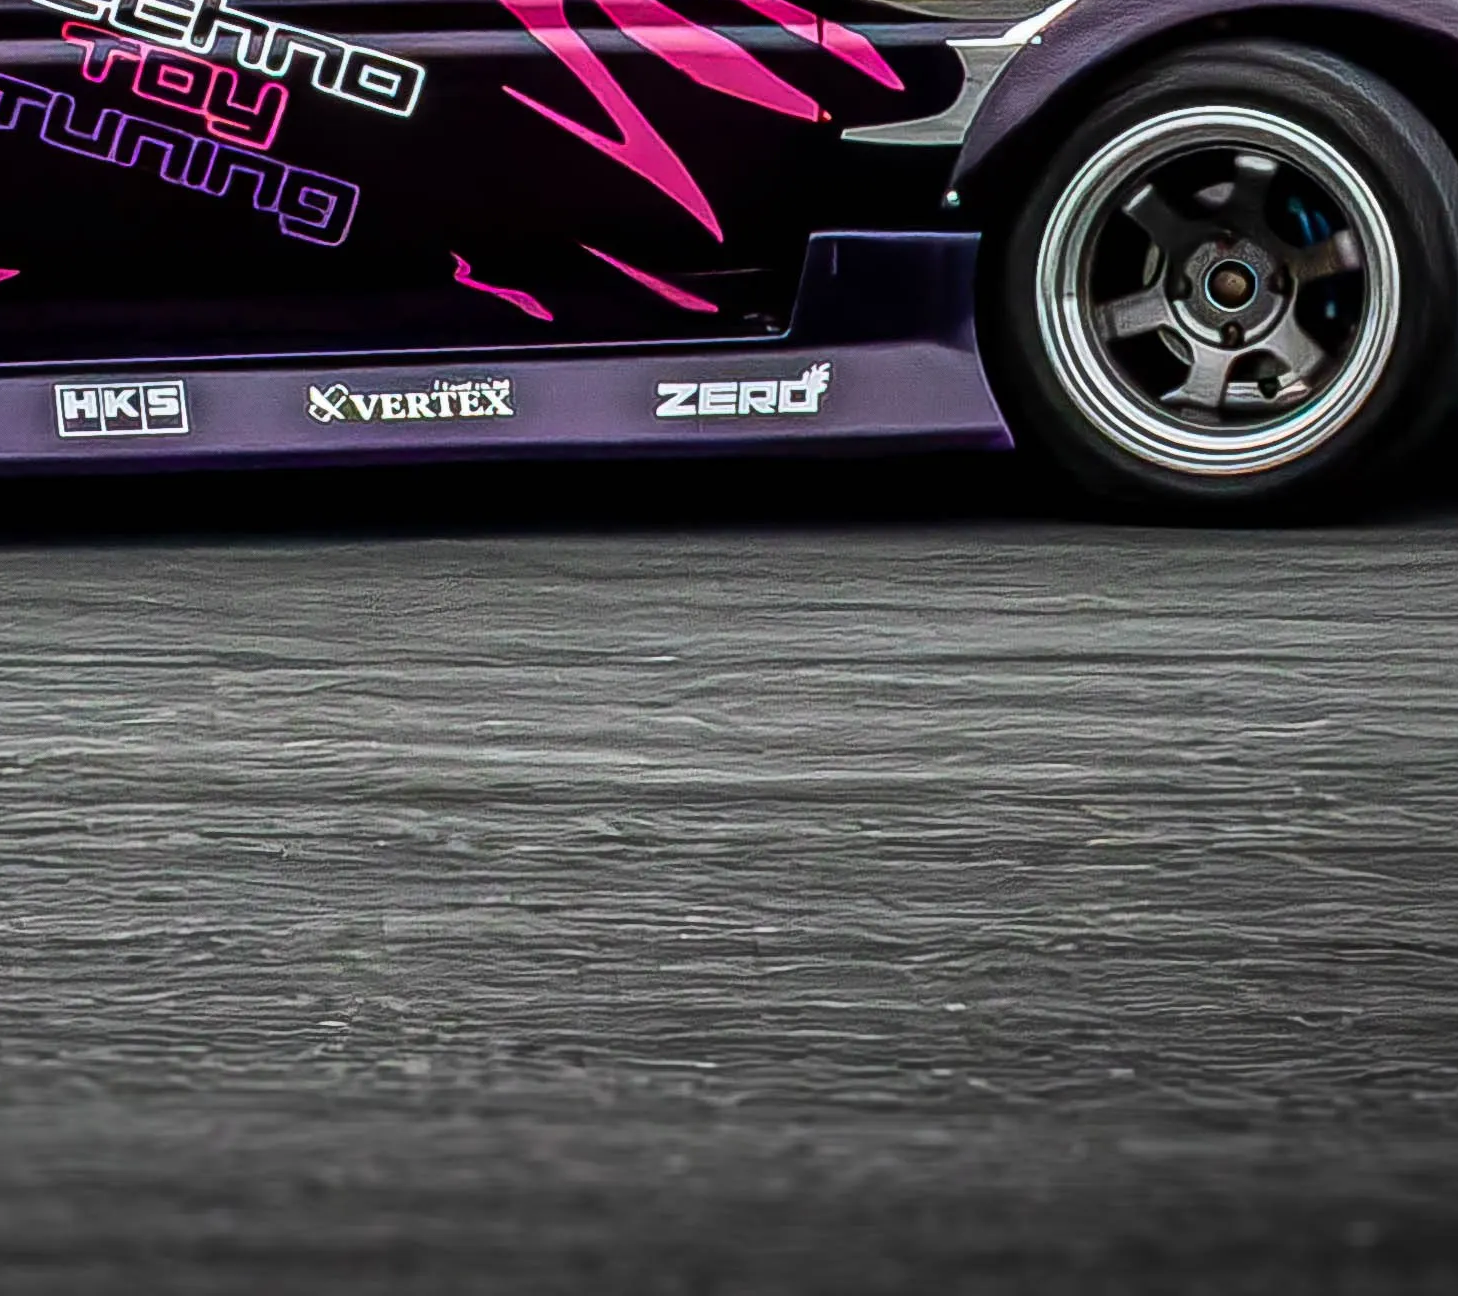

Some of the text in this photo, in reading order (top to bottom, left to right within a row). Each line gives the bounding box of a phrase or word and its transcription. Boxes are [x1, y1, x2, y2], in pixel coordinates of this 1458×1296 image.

[63, 387, 180, 420] HKS
[348, 389, 515, 422] VERTEX
[655, 374, 822, 417] ZERO
